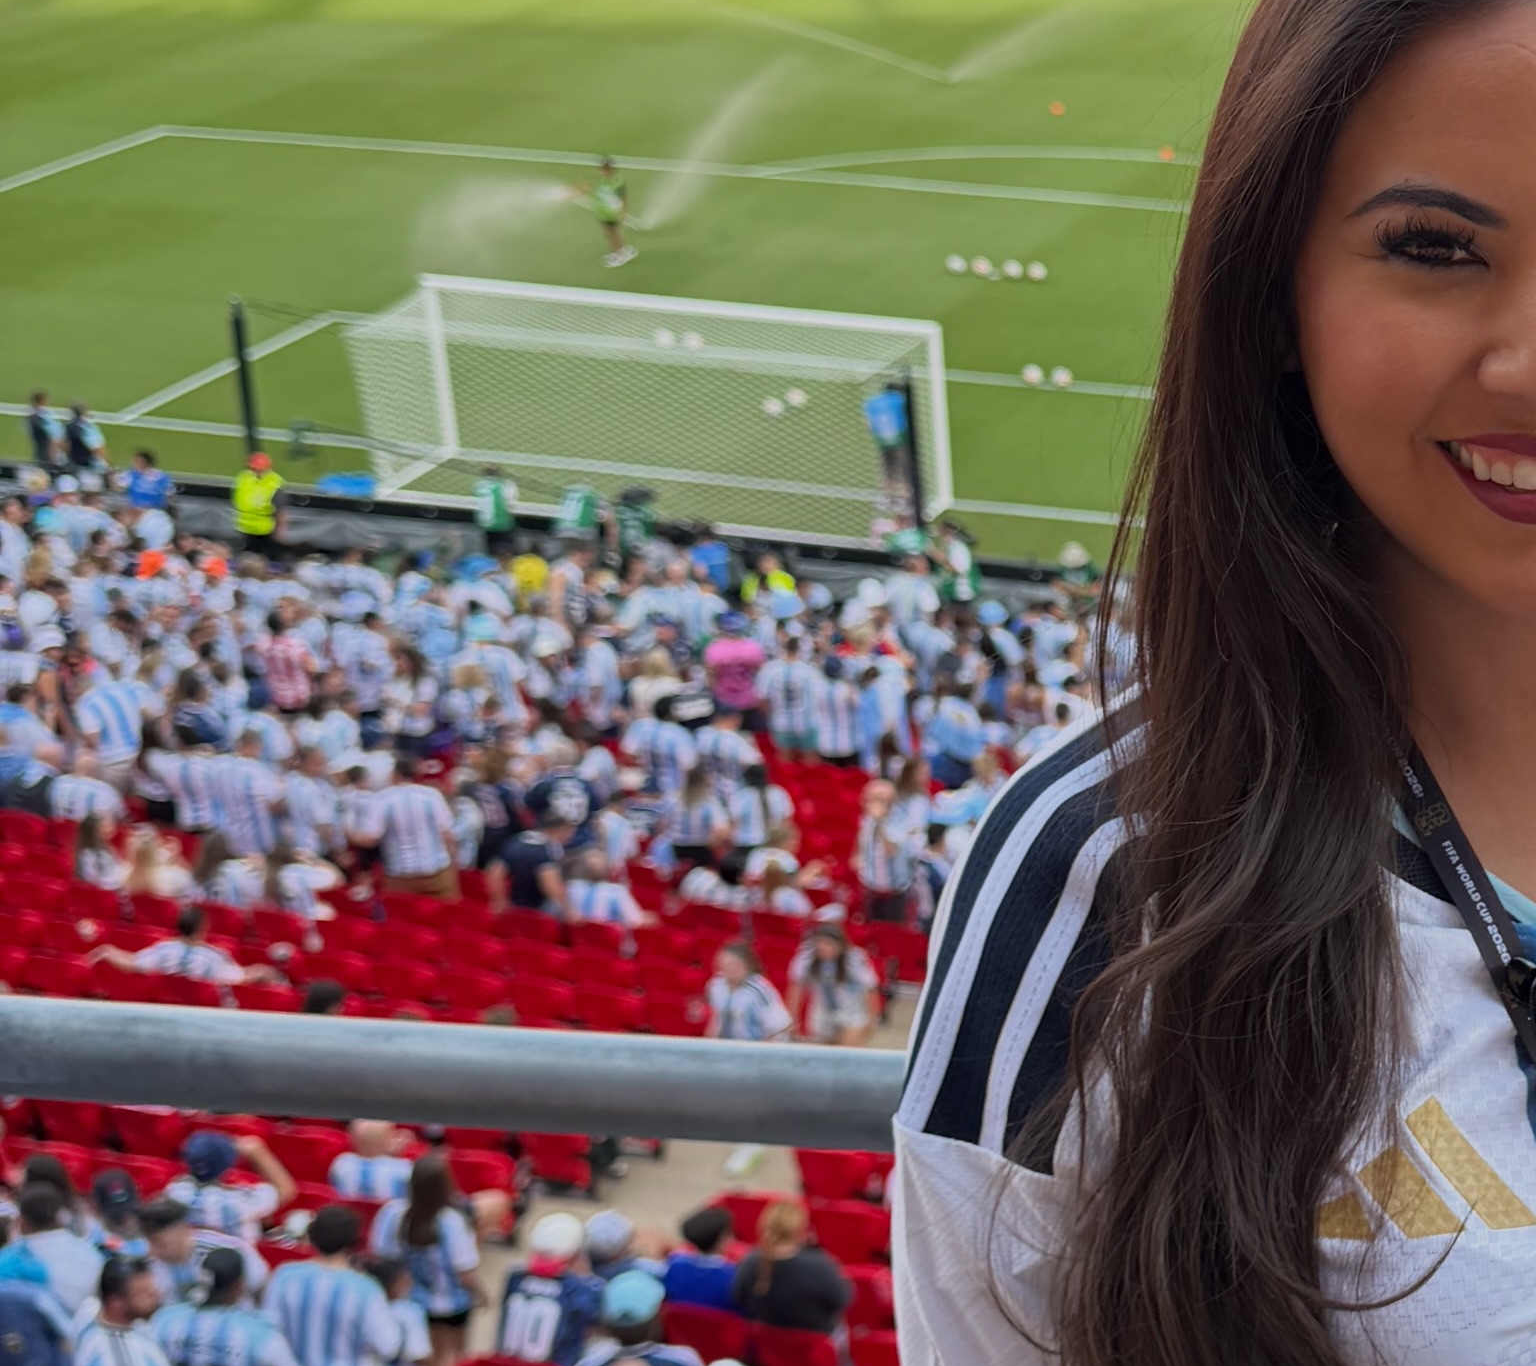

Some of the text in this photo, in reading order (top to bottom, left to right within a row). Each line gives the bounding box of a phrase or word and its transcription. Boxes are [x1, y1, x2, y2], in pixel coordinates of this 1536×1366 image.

[1441, 839, 1460, 865] FIFA
[1455, 862, 1482, 903] WORLD
[1475, 900, 1494, 924] CUP
